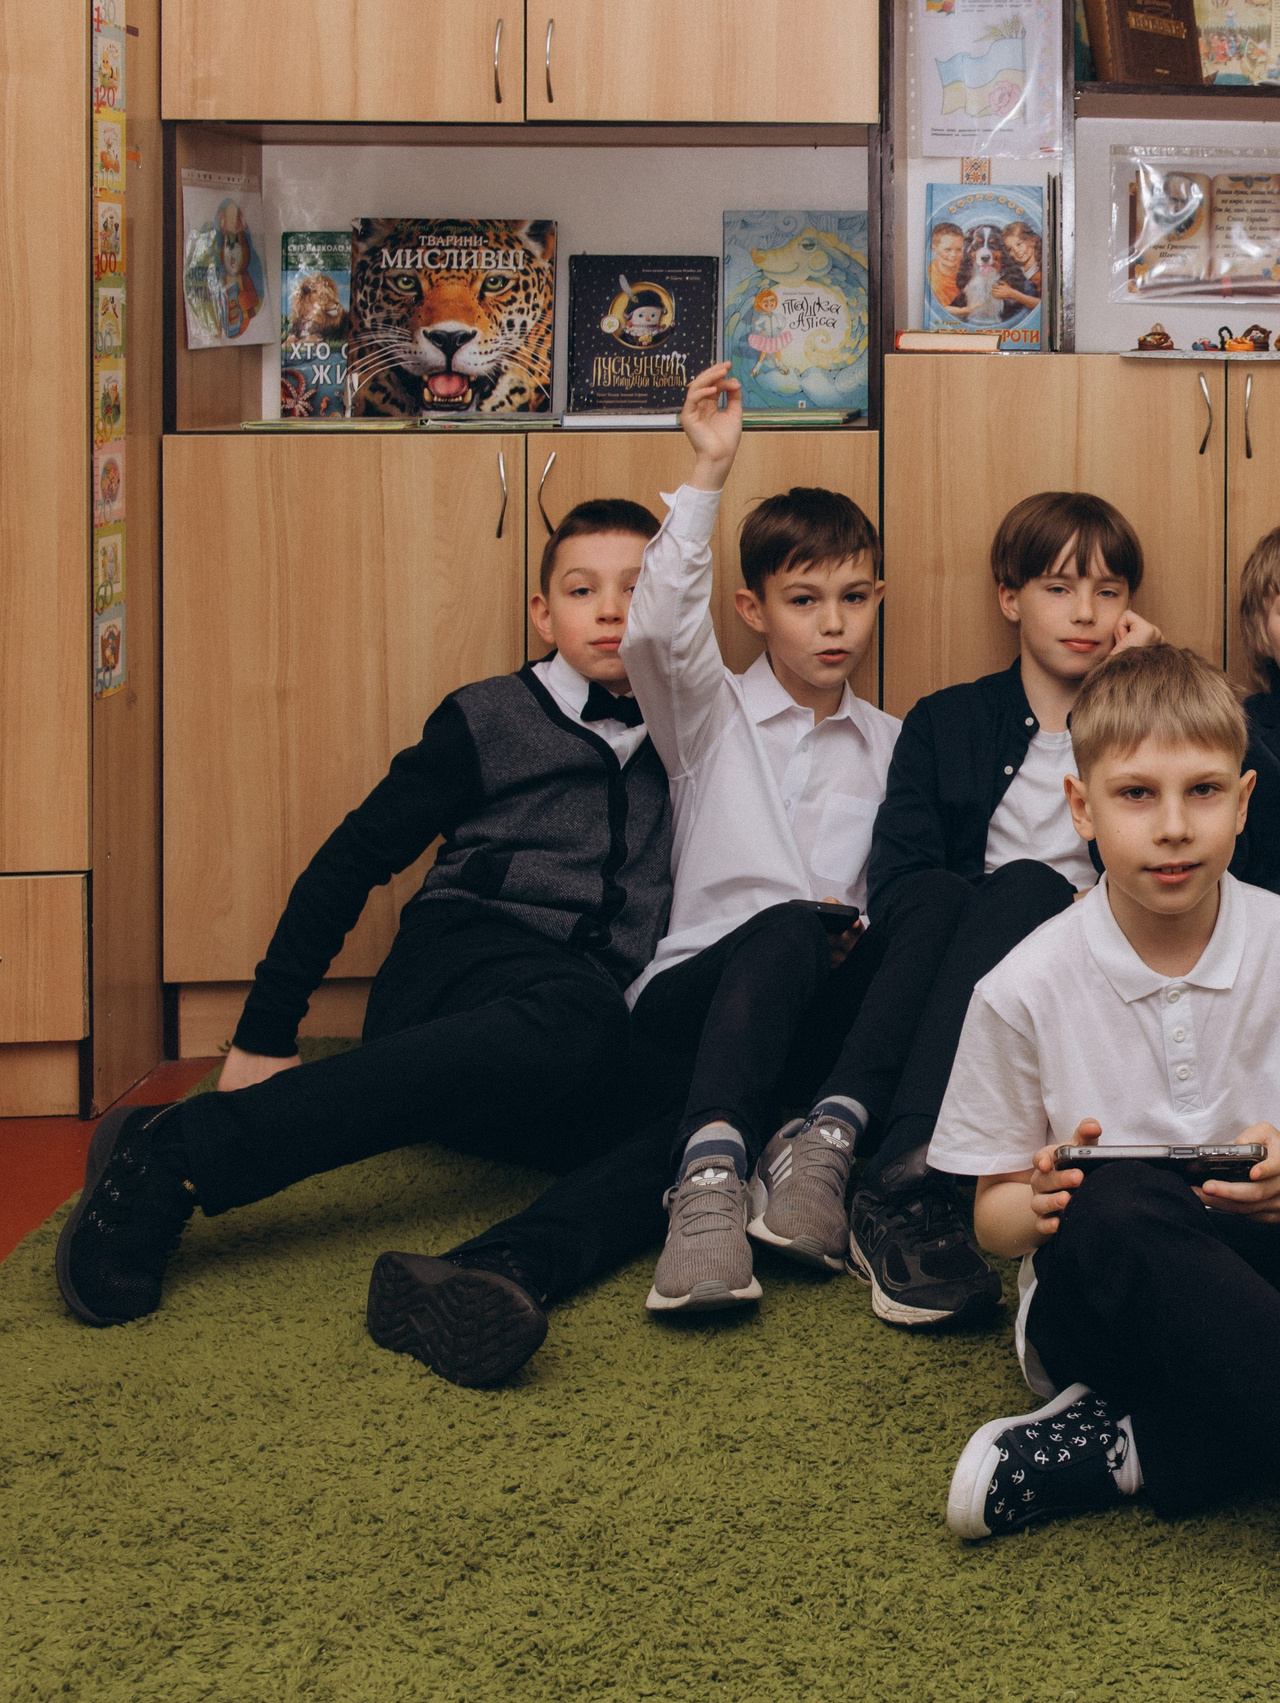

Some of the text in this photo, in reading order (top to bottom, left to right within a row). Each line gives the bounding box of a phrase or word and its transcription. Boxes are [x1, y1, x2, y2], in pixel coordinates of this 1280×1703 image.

[94, 85, 115, 114] 120
[418, 235, 489, 248] ТВАРИНИ-
[94, 251, 117, 281] 100
[380, 248, 525, 273] МИСЛИВЦІ
[789, 311, 838, 332] Аліса
[289, 342, 331, 360] ХТО
[589, 351, 691, 388] ЛУСКУНЧИК
